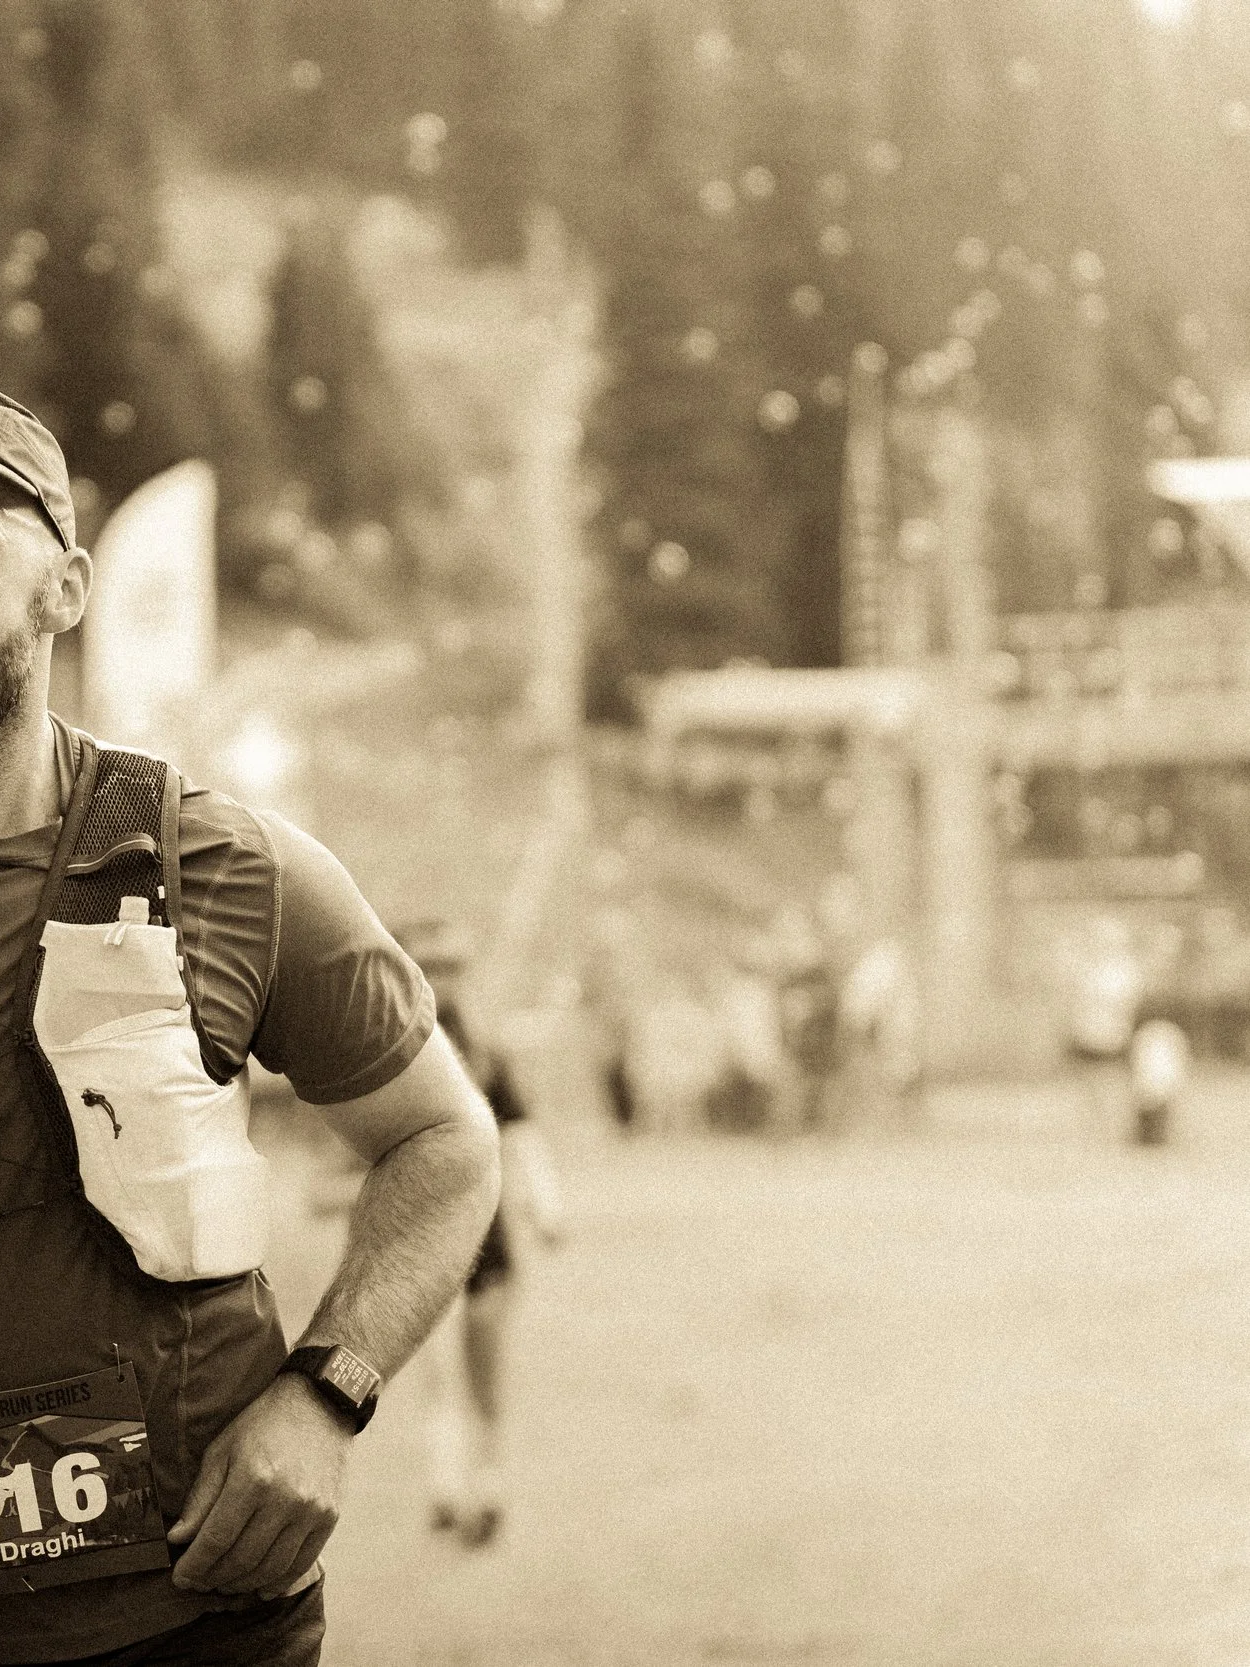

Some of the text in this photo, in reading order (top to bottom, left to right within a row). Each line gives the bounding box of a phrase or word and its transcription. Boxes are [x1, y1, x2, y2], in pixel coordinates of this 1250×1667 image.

[1, 1393, 34, 1417] RUN
[37, 1382, 92, 1412] SERIES
[0, 1528, 86, 1562] Draghi
